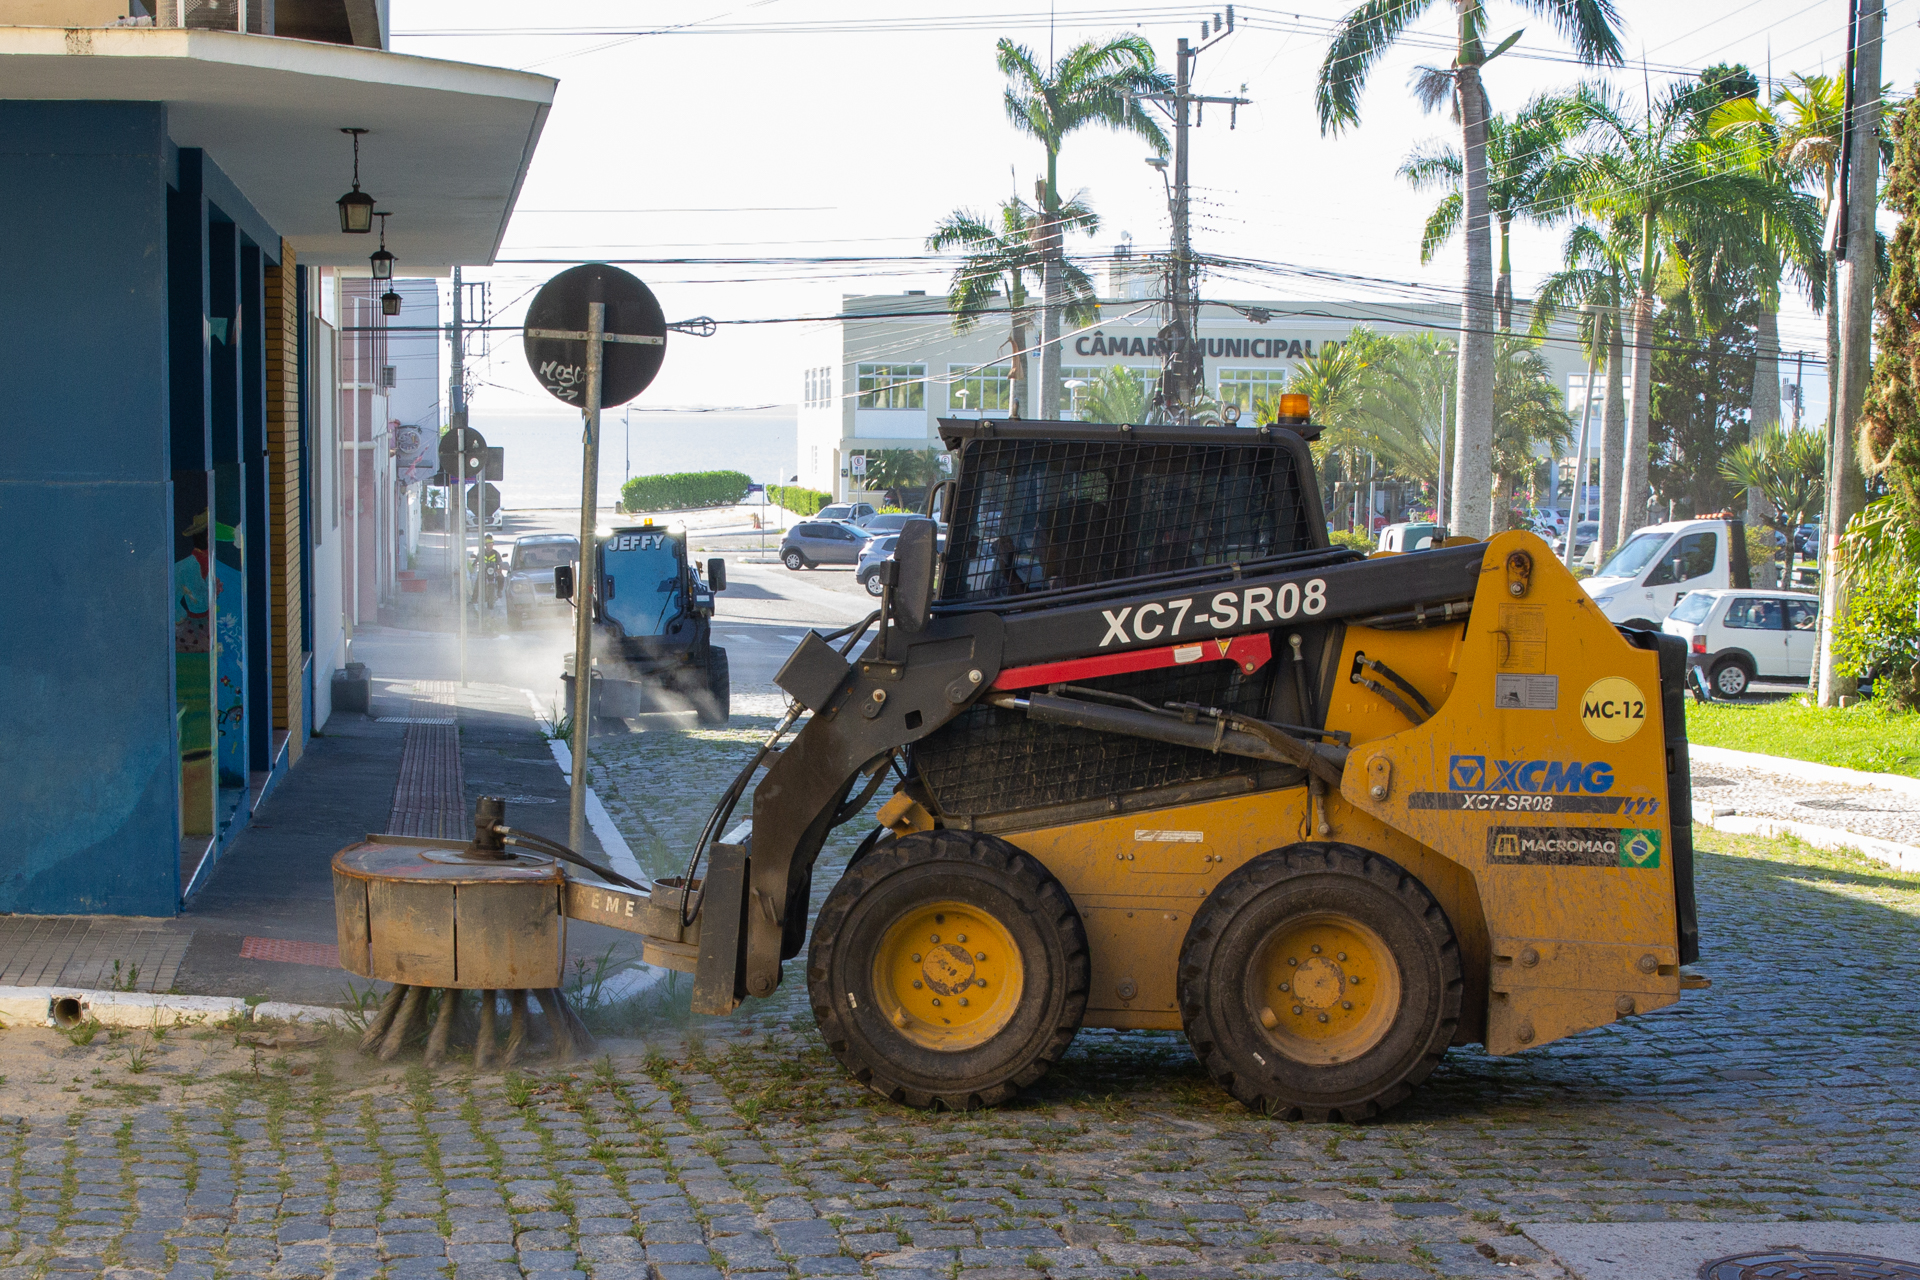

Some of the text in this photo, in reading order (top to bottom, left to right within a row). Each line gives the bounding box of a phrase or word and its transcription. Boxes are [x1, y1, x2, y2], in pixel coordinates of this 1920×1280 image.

[1075, 330, 1164, 357] CÂMAR
[1190, 337, 1317, 359] MUNICIPAL
[607, 534, 665, 551] JEFFY
[1098, 578, 1327, 647] XC7-SR08
[1582, 700, 1644, 719] MC-12
[1485, 760, 1615, 794] XCMG
[1462, 794, 1553, 811] XC7-SR08
[1521, 839, 1616, 854] MACROMAQ
